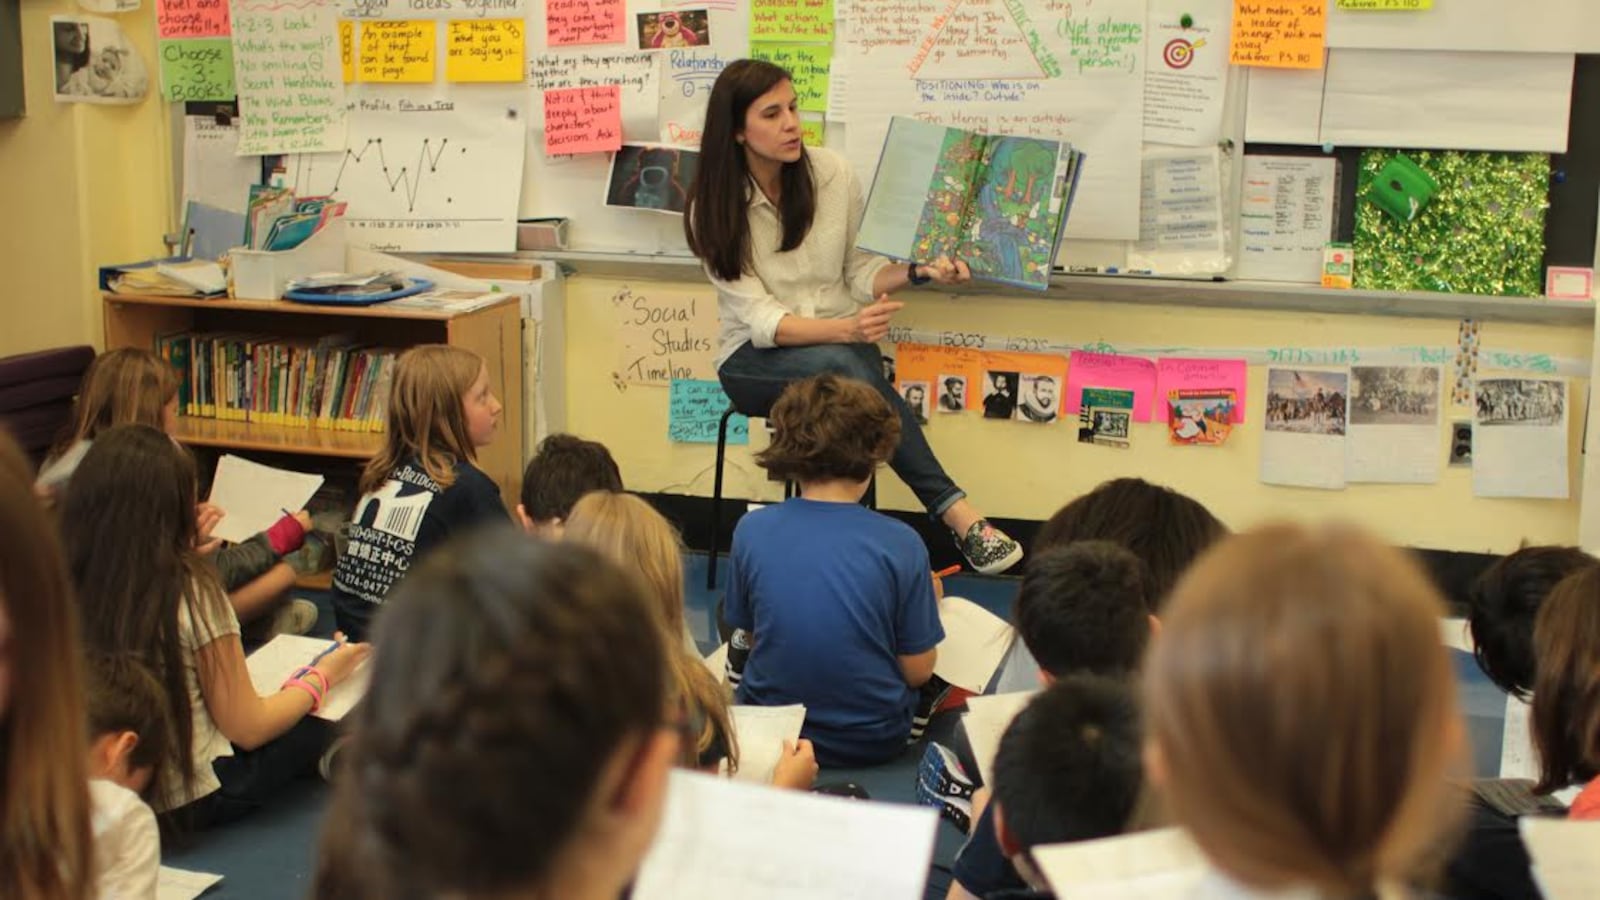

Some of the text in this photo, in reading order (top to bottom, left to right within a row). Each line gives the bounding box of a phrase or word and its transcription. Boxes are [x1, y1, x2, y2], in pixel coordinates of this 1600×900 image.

[548, 0, 590, 13] reading
[452, 23, 497, 34] I think
[1097, 17, 1143, 40] always
[1287, 18, 1299, 29] of
[362, 30, 378, 42] An
[481, 36, 502, 49] you
[367, 38, 379, 52] of
[164, 44, 223, 63] Choose
[361, 57, 378, 65] can
[384, 54, 395, 64] be
[537, 55, 560, 68] What
[364, 66, 404, 80] on page
[632, 296, 696, 326] Social
[651, 328, 711, 356] Studies
[626, 355, 693, 381] Timeline
[673, 383, 681, 394] I
